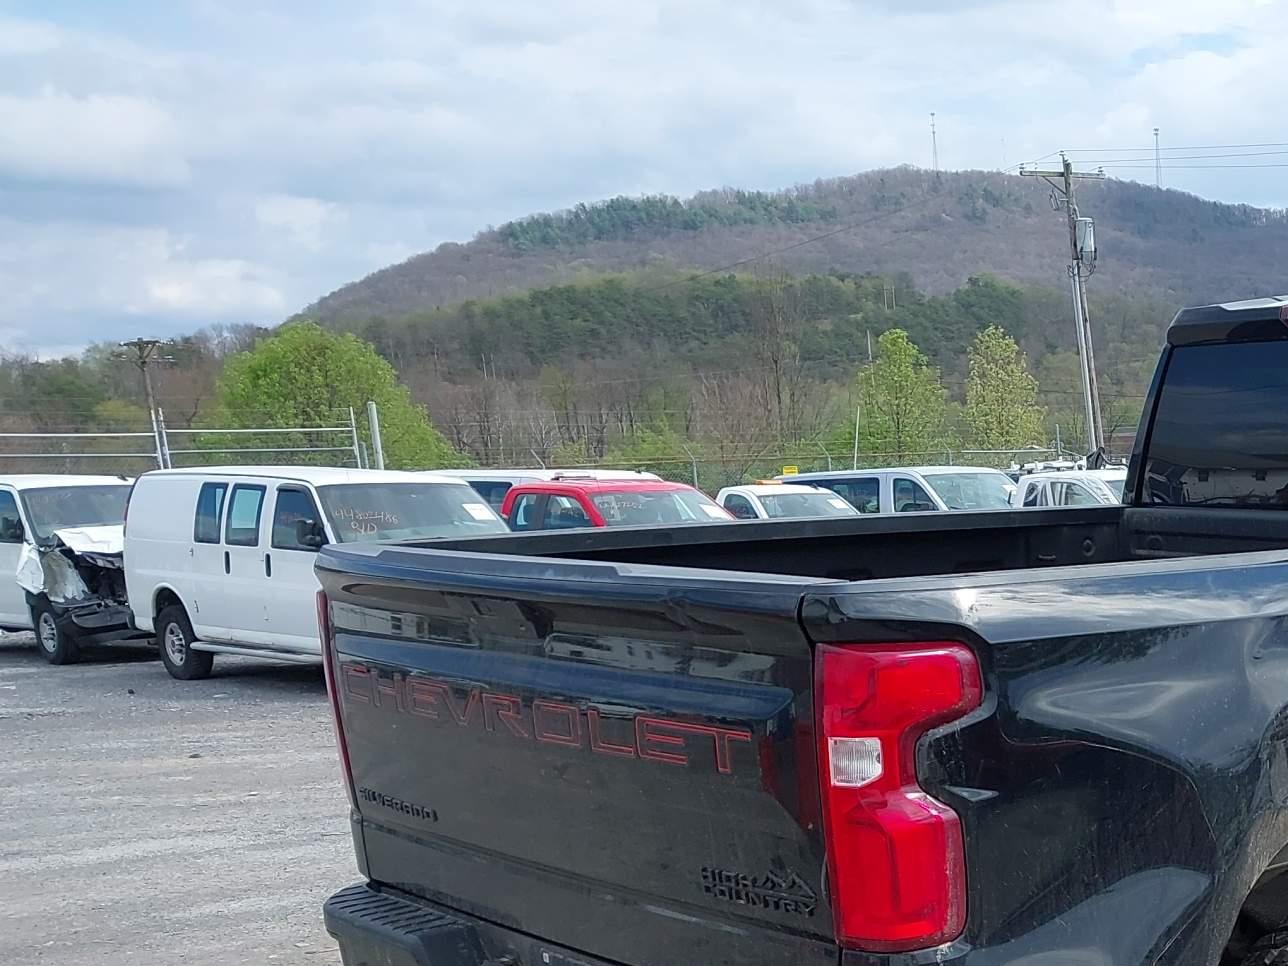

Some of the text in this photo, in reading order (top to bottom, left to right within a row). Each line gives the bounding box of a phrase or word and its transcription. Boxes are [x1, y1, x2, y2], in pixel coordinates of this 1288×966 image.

[341, 663, 752, 774] CHEVROLET
[359, 785, 439, 822] SILVERADO
[702, 866, 751, 888] HIGH
[703, 883, 817, 917] COUNTRY
